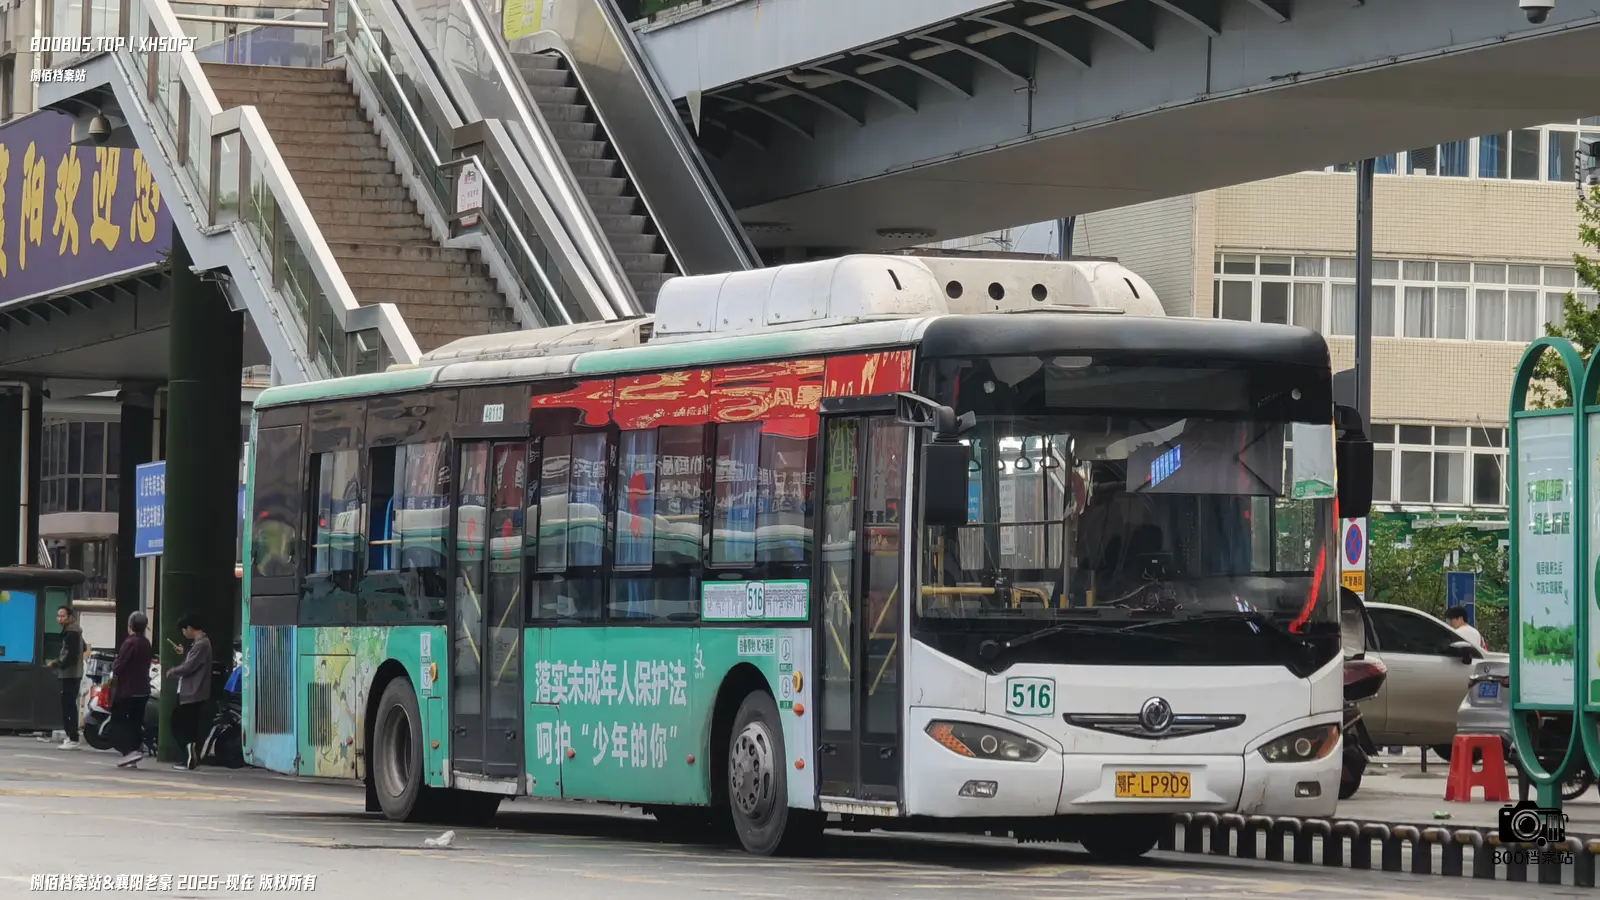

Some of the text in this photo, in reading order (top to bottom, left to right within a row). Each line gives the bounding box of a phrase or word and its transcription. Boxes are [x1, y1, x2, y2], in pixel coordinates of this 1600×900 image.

[748, 588, 763, 611] 516
[535, 659, 688, 707] 落实未成年人保护法
[1012, 683, 1051, 709] 516
